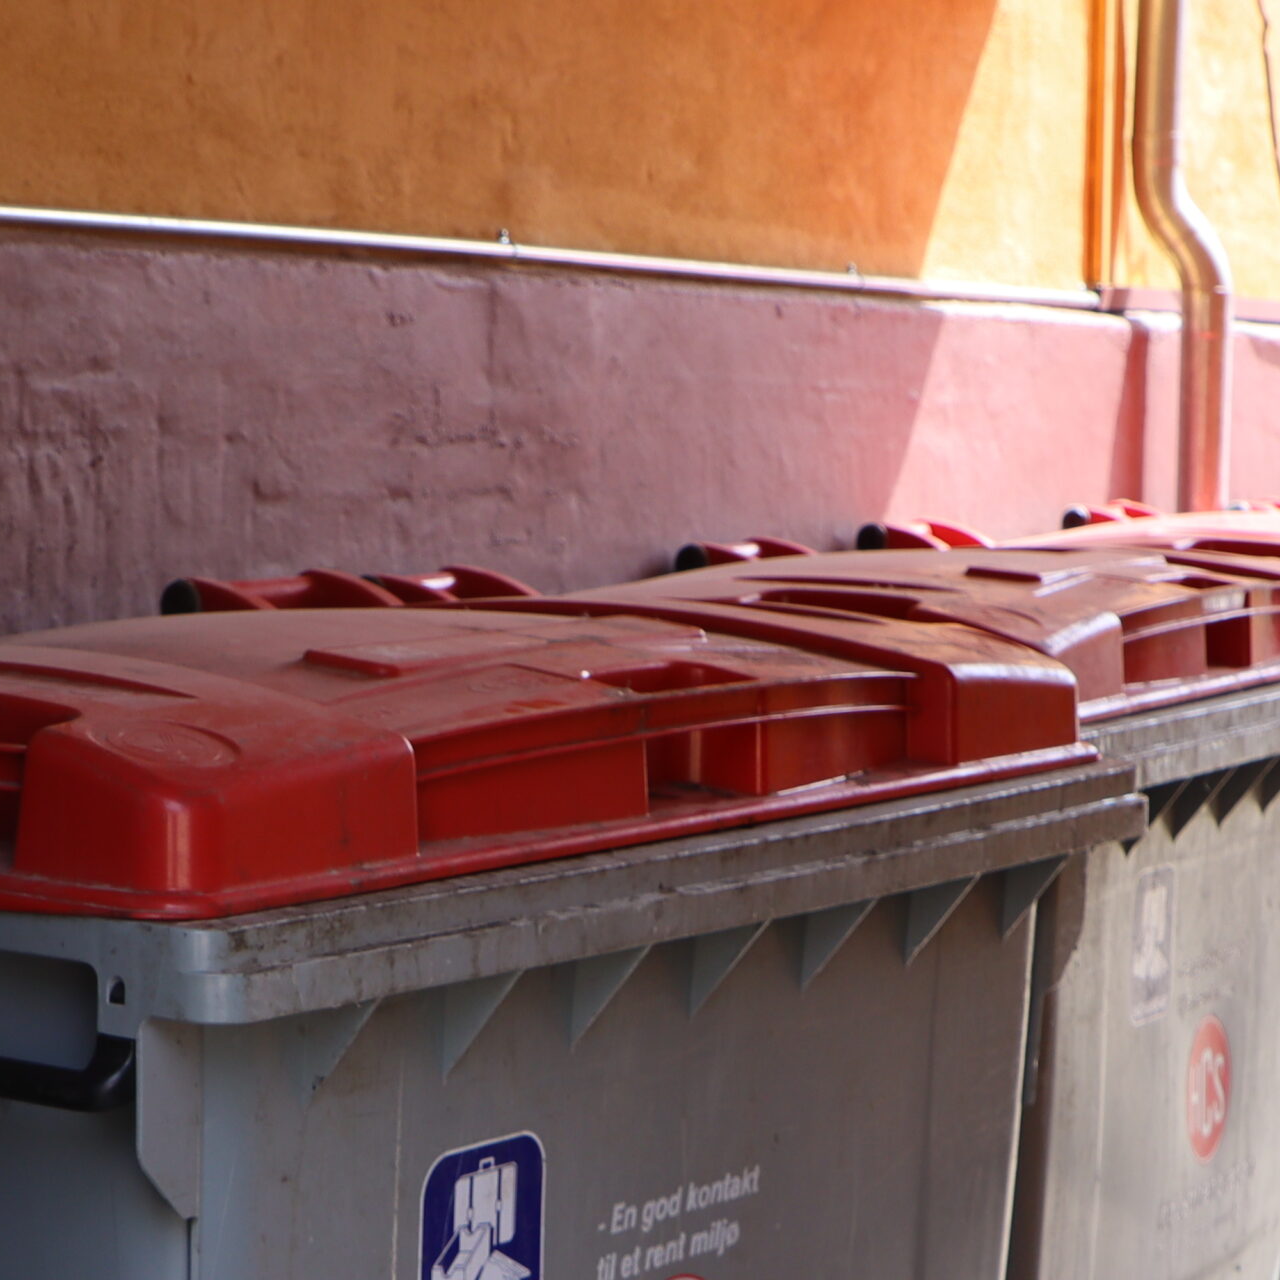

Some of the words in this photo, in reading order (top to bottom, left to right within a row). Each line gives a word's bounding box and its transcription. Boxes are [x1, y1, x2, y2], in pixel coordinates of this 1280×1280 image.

[1190, 1047, 1225, 1137] HCS
[610, 1201, 638, 1235] En
[641, 1185, 683, 1233] god
[686, 1163, 761, 1213] kontakt
[620, 1245, 641, 1279] et
[644, 1231, 686, 1271] rent
